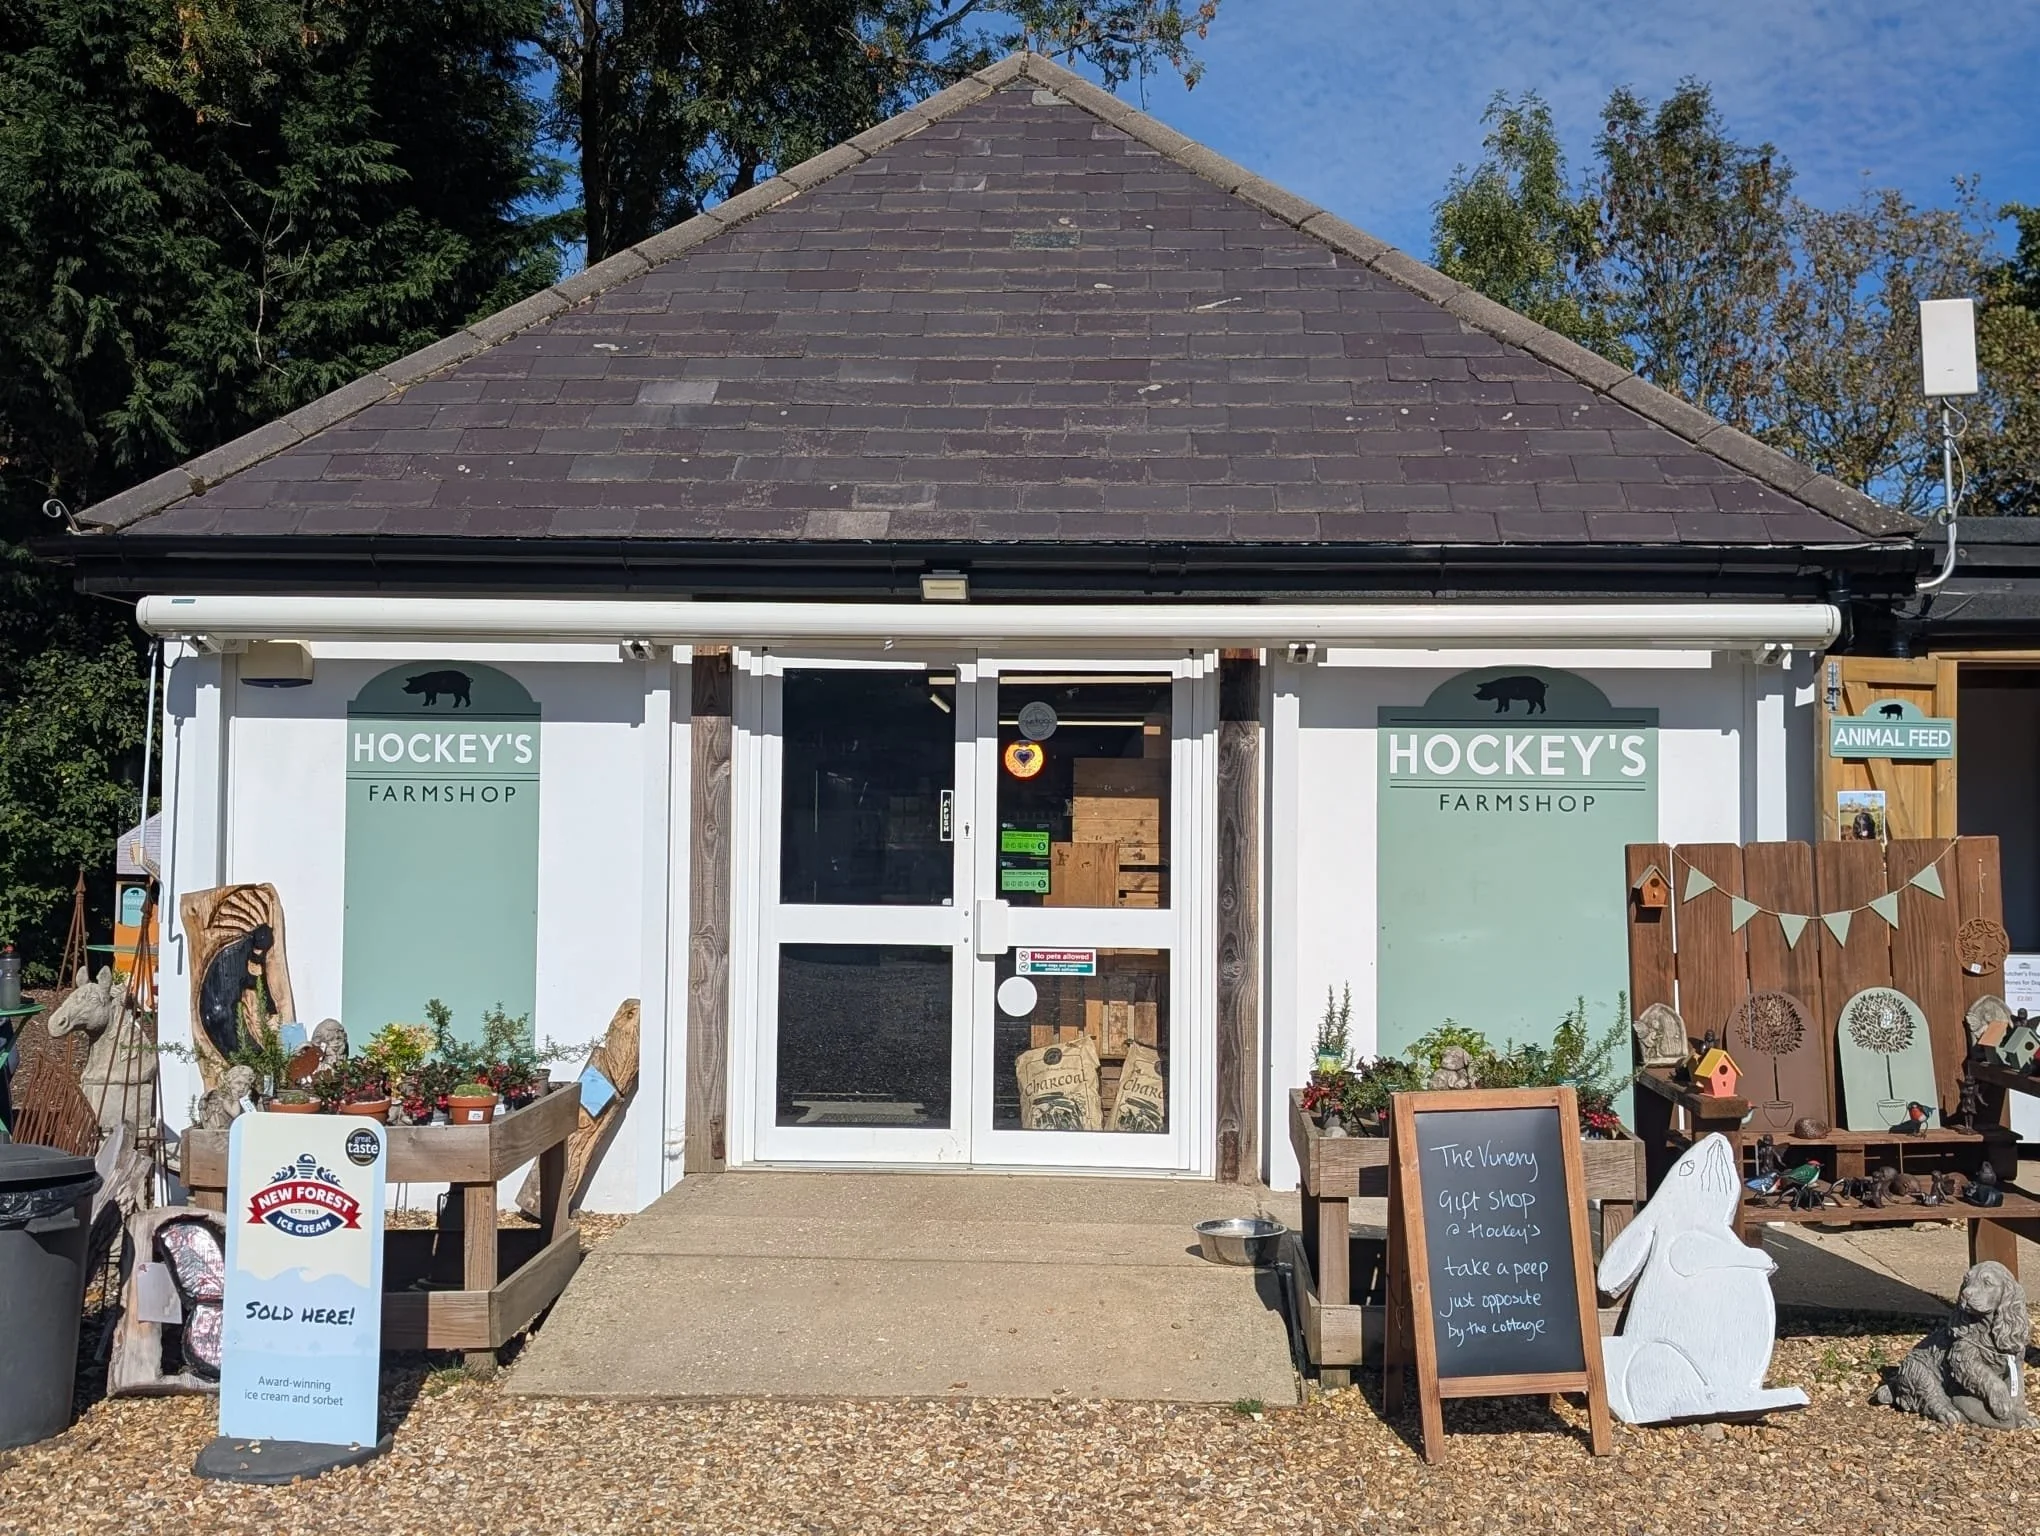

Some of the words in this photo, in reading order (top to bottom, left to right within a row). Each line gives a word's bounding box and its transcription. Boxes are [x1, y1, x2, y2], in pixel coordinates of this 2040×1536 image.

[1834, 728, 1905, 746] ANIMAL
[1909, 729, 1951, 747] FEED
[354, 732, 533, 764] HOCKEY'S
[1389, 733, 1647, 777] HOCKEY'S
[369, 785, 516, 803] FARMSHOP
[1439, 793, 1596, 813] FARMSHOP
[1046, 953, 1061, 961] pets
[1024, 1072, 1088, 1098] Charcoal
[347, 1142, 378, 1154] taste
[354, 1136, 372, 1144] great
[1430, 1143, 1476, 1168] The
[1478, 1140, 1539, 1183] Vinery
[258, 1187, 293, 1210] NEW
[296, 1187, 353, 1211] FOREST
[276, 1217, 293, 1231] ICE
[295, 1219, 332, 1234] CREAM
[1444, 1255, 1492, 1277] take
[1496, 1262, 1510, 1276] a
[1514, 1260, 1549, 1283] peep
[1439, 1288, 1476, 1318] just
[1481, 1289, 1542, 1315] opposite
[301, 1307, 355, 1326] HERE!
[1447, 1322, 1465, 1348] by
[1467, 1320, 1487, 1335] the
[1492, 1316, 1547, 1342] cottage
[258, 1375, 331, 1392] Award-winning
[244, 1389, 259, 1400] ice
[260, 1392, 290, 1403] cream
[292, 1392, 310, 1404] and
[312, 1394, 344, 1406] sorbet
